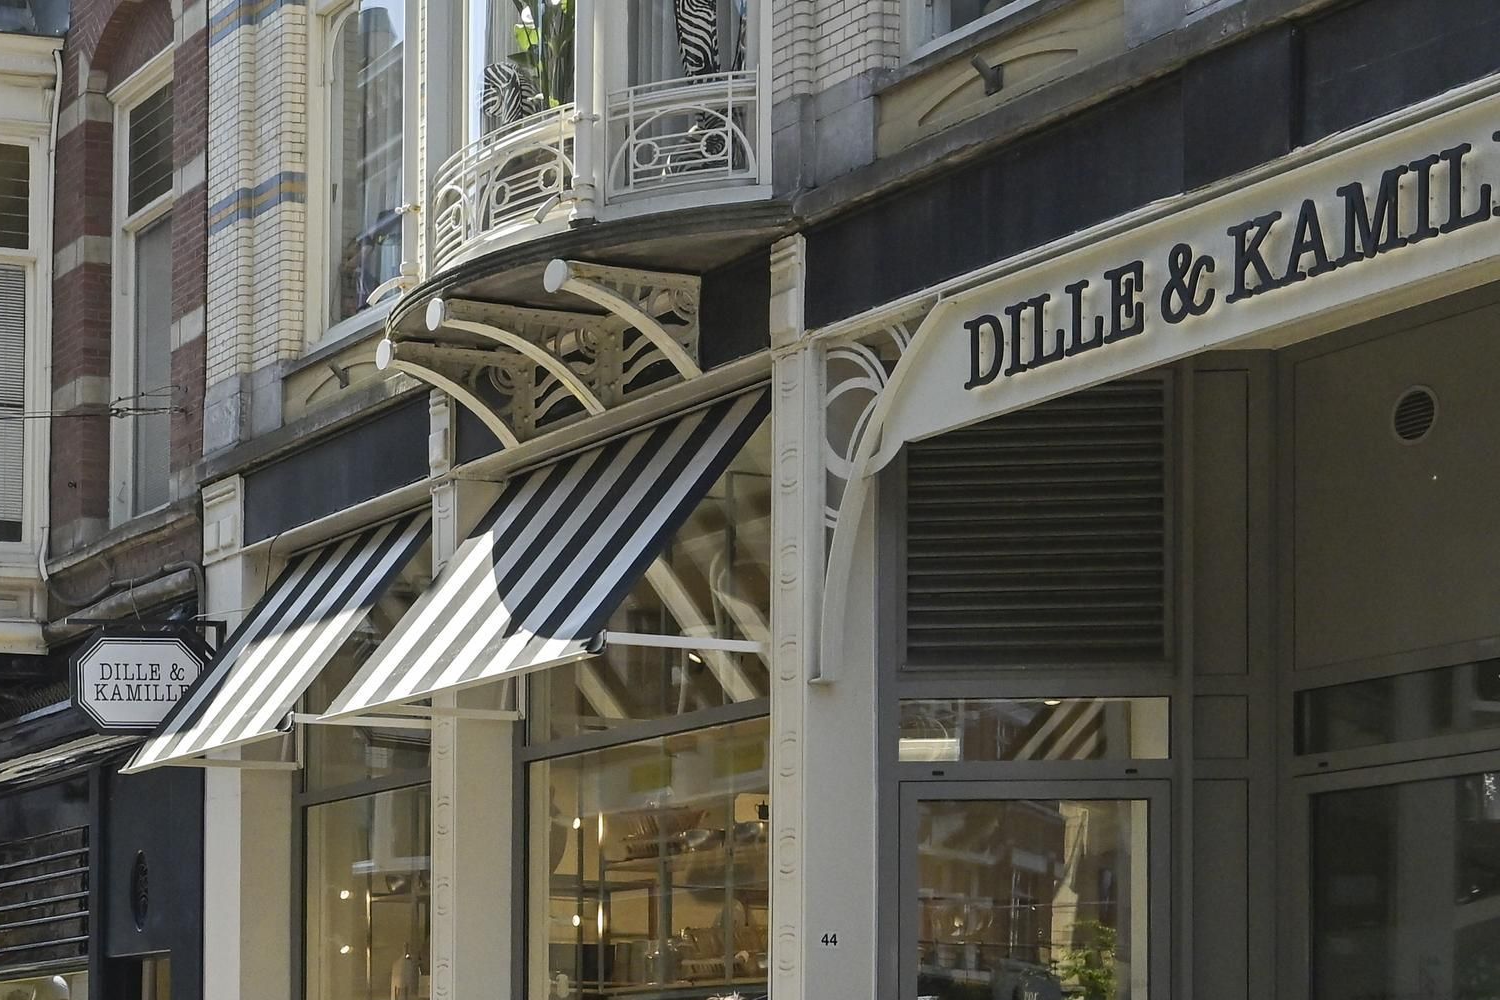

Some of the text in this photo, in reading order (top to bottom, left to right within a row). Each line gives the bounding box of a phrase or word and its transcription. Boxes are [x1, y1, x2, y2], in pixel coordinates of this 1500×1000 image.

[963, 260, 1145, 390] DILLE
[1161, 243, 1216, 324] &
[100, 662, 185, 681] DILLE &
[821, 933, 838, 946] 44
